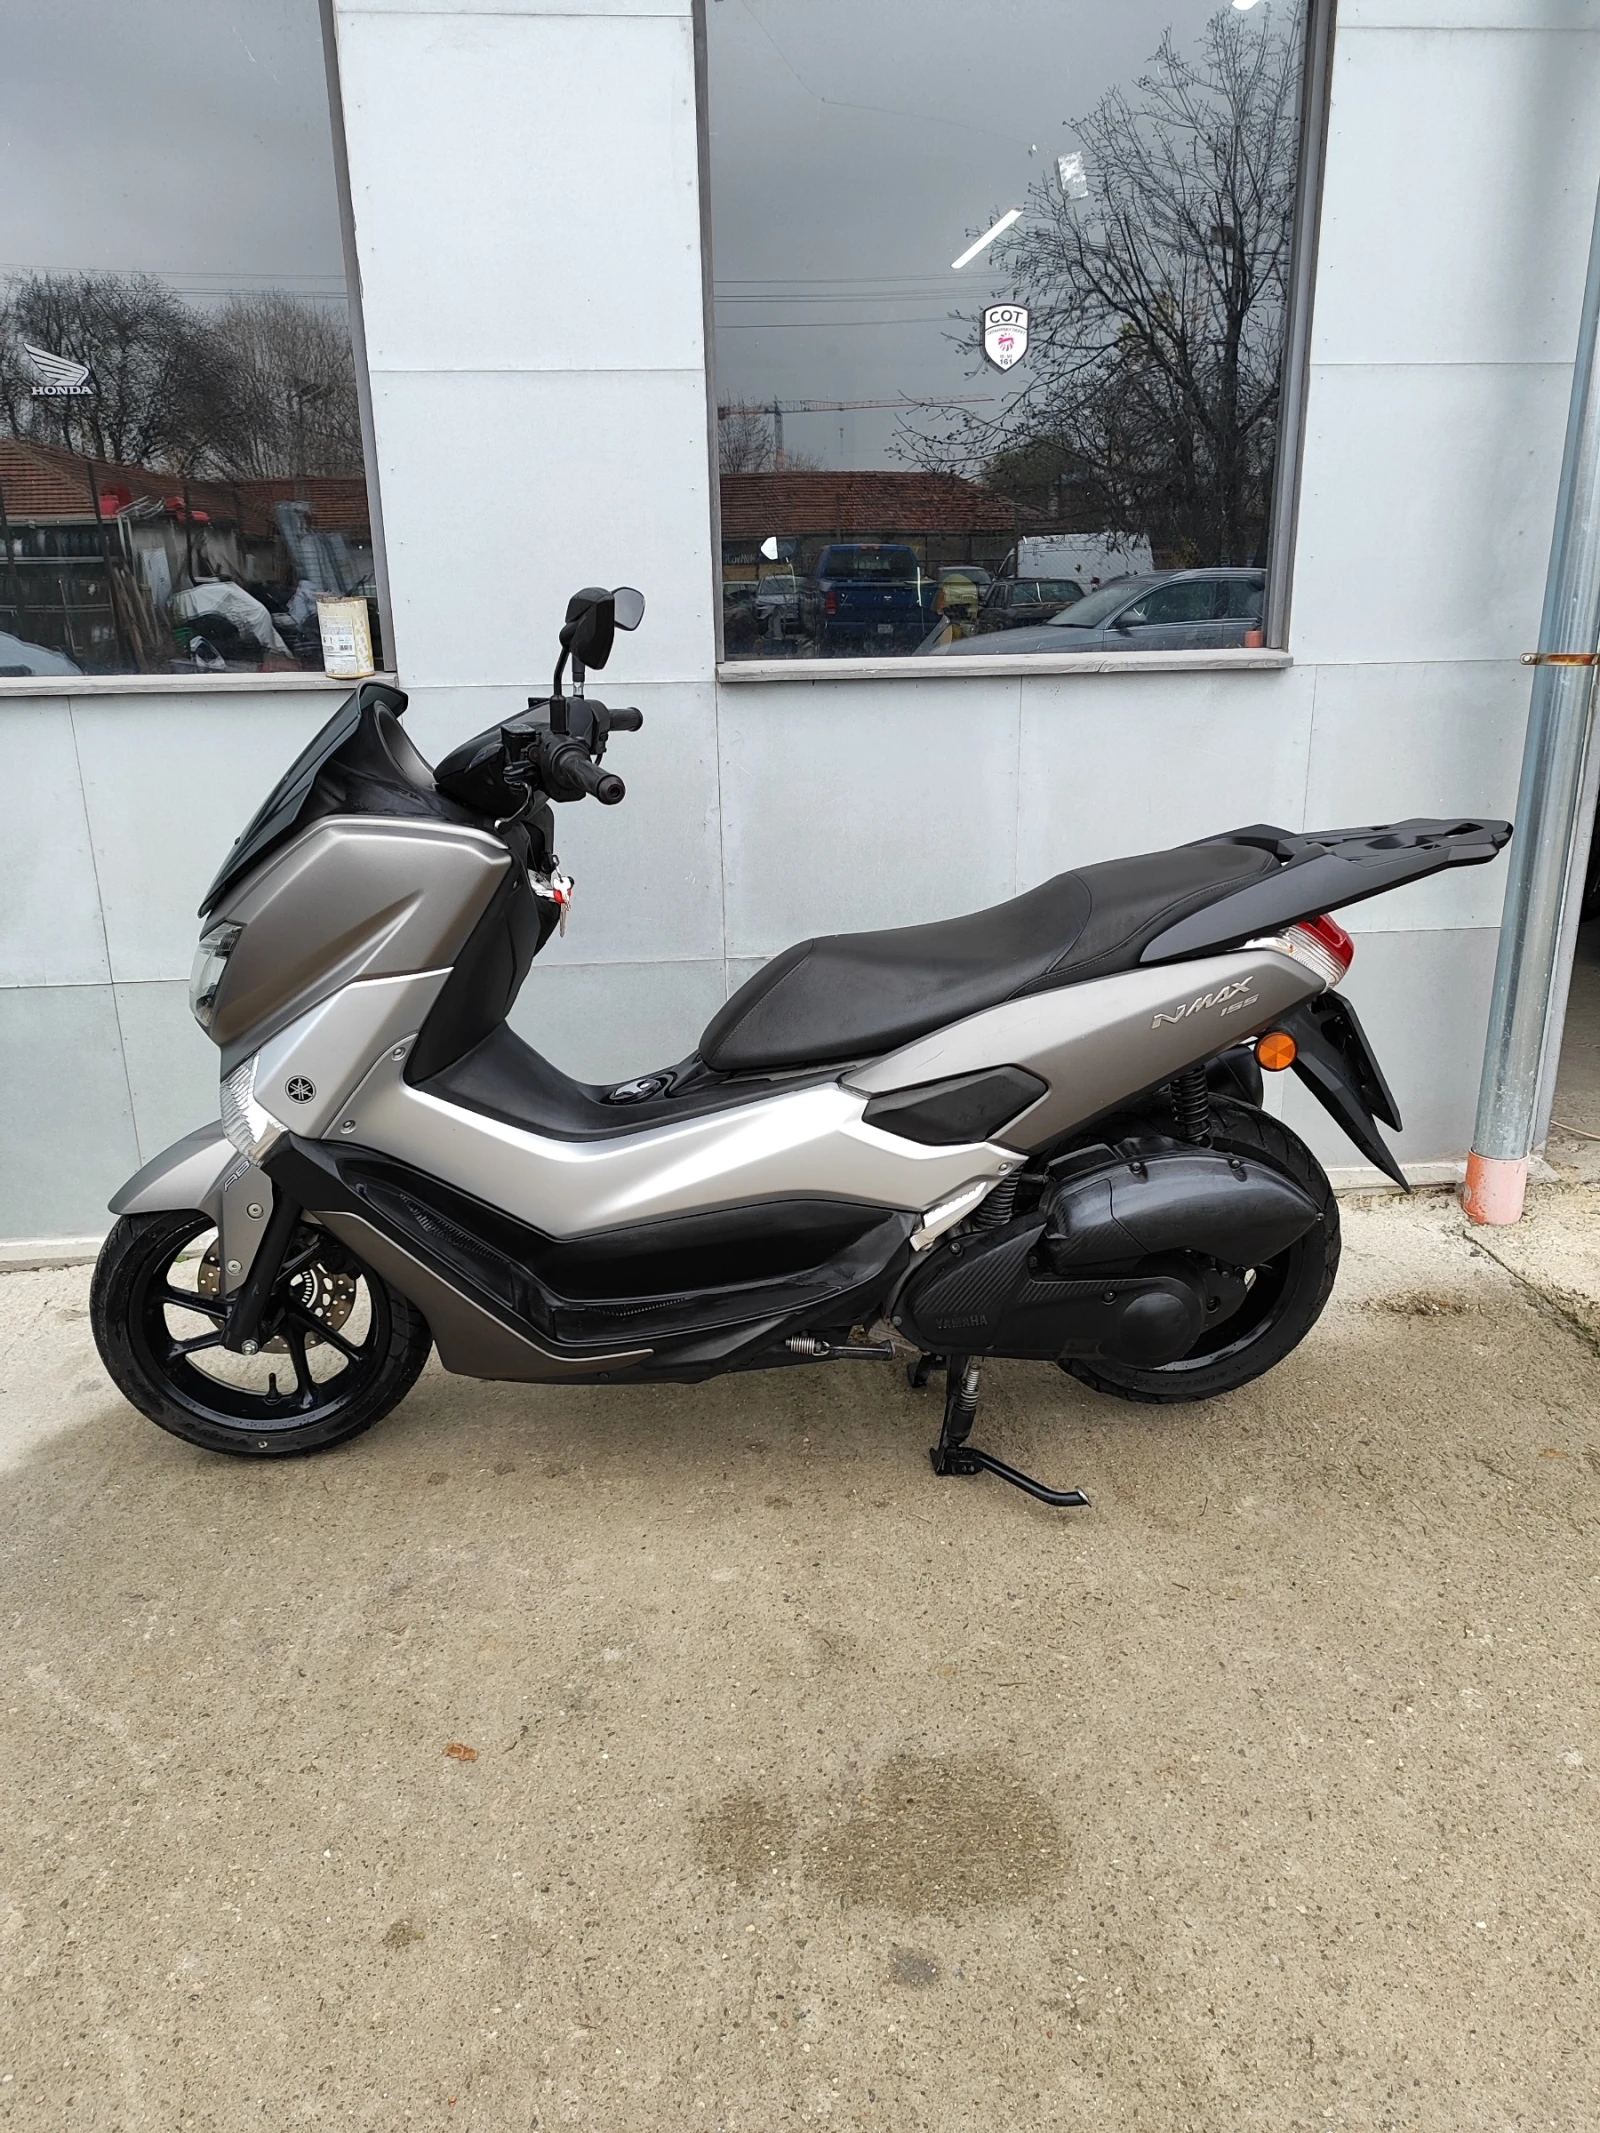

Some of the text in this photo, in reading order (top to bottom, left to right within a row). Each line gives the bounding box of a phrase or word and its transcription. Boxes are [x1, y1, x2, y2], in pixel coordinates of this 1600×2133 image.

[999, 358, 1013, 366] 161
[31, 386, 94, 395] HONDA
[1151, 976, 1253, 1029] NMAX
[1220, 994, 1260, 1017] 155
[935, 1314, 988, 1329] YAMAHA
